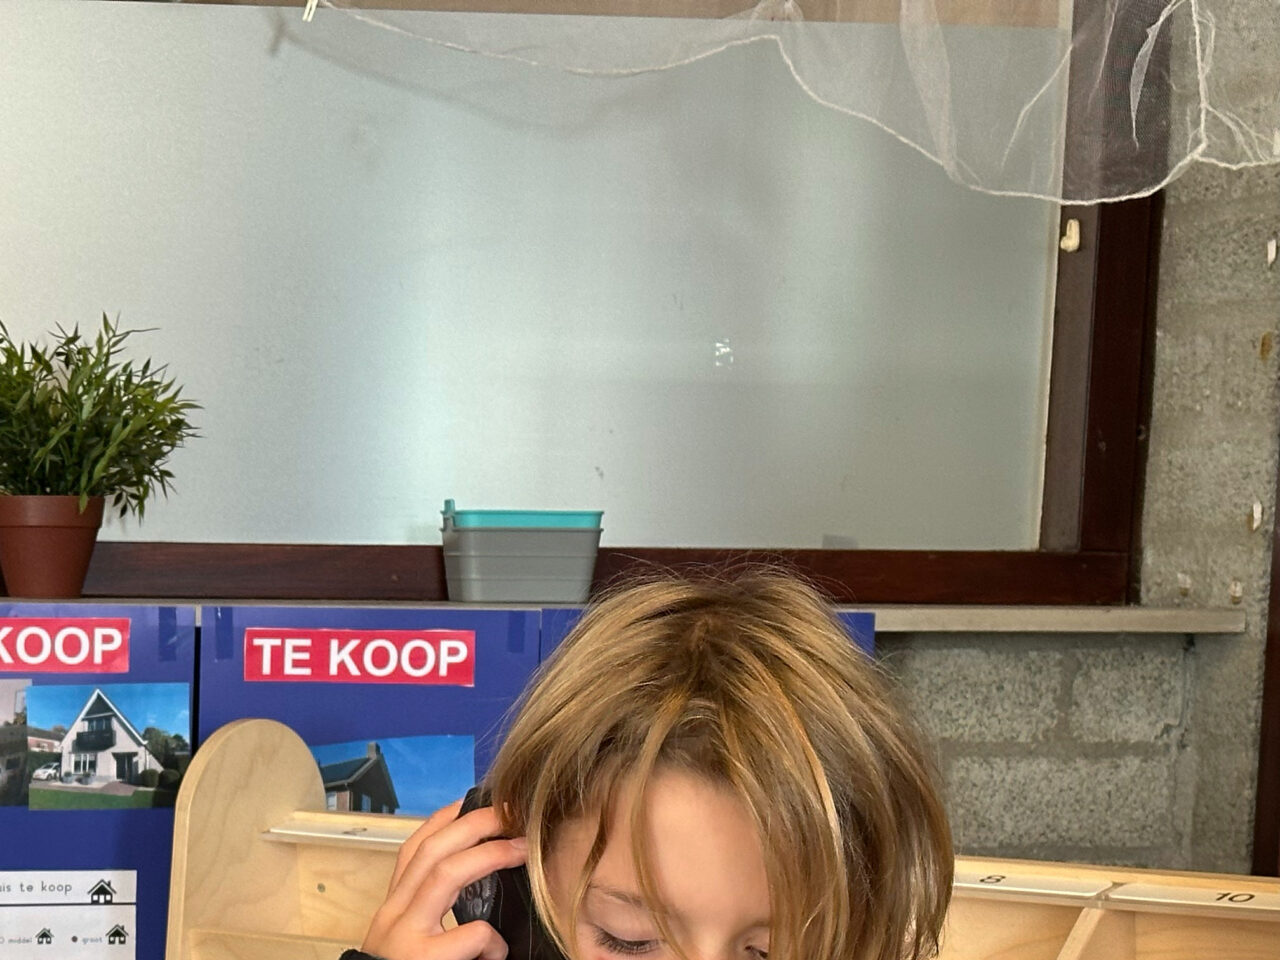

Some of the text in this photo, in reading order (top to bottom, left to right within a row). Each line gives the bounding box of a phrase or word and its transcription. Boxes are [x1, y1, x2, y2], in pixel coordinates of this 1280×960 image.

[253, 638, 469, 678] TE KOOP
[979, 874, 1006, 885] 8
[20, 882, 33, 893] te
[41, 881, 72, 895] koop
[1215, 891, 1255, 904] 10
